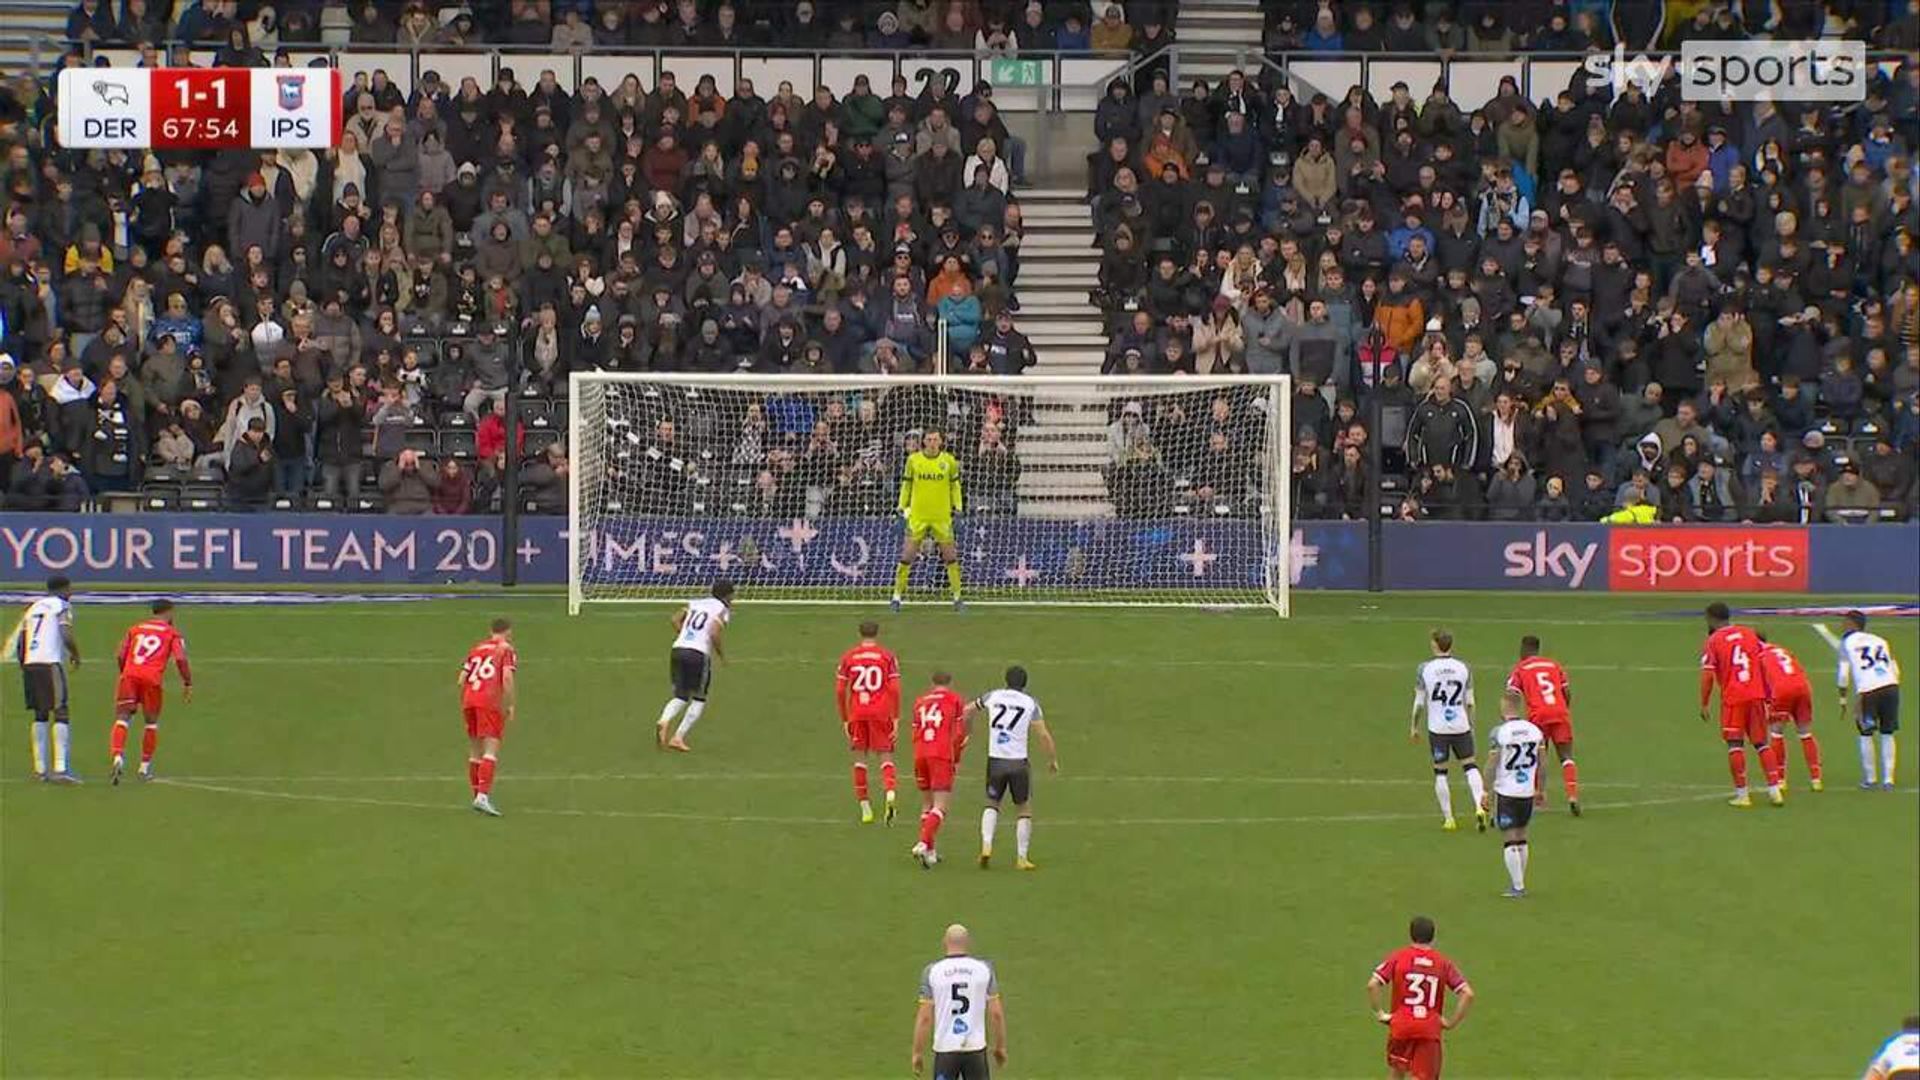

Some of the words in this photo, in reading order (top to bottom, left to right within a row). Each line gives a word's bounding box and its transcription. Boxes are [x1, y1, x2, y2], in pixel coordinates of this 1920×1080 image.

[1, 527, 154, 570] YOUR
[173, 529, 258, 570] EFL
[272, 529, 416, 571] TEAM
[436, 530, 496, 571] 20
[1504, 531, 1597, 588] sky
[1619, 539, 1796, 586] sports
[686, 610, 708, 630] 10
[132, 633, 161, 657] 19
[1731, 645, 1749, 671] 4
[1856, 646, 1888, 670] 34
[468, 656, 496, 682] 26
[850, 665, 882, 691] 20
[1432, 680, 1463, 706] 42
[1536, 672, 1554, 696] 5
[918, 703, 943, 729] 14
[992, 703, 1025, 731] 27
[1505, 742, 1536, 770] 23
[951, 982, 970, 1015] 5
[1404, 973, 1438, 1008] 31
